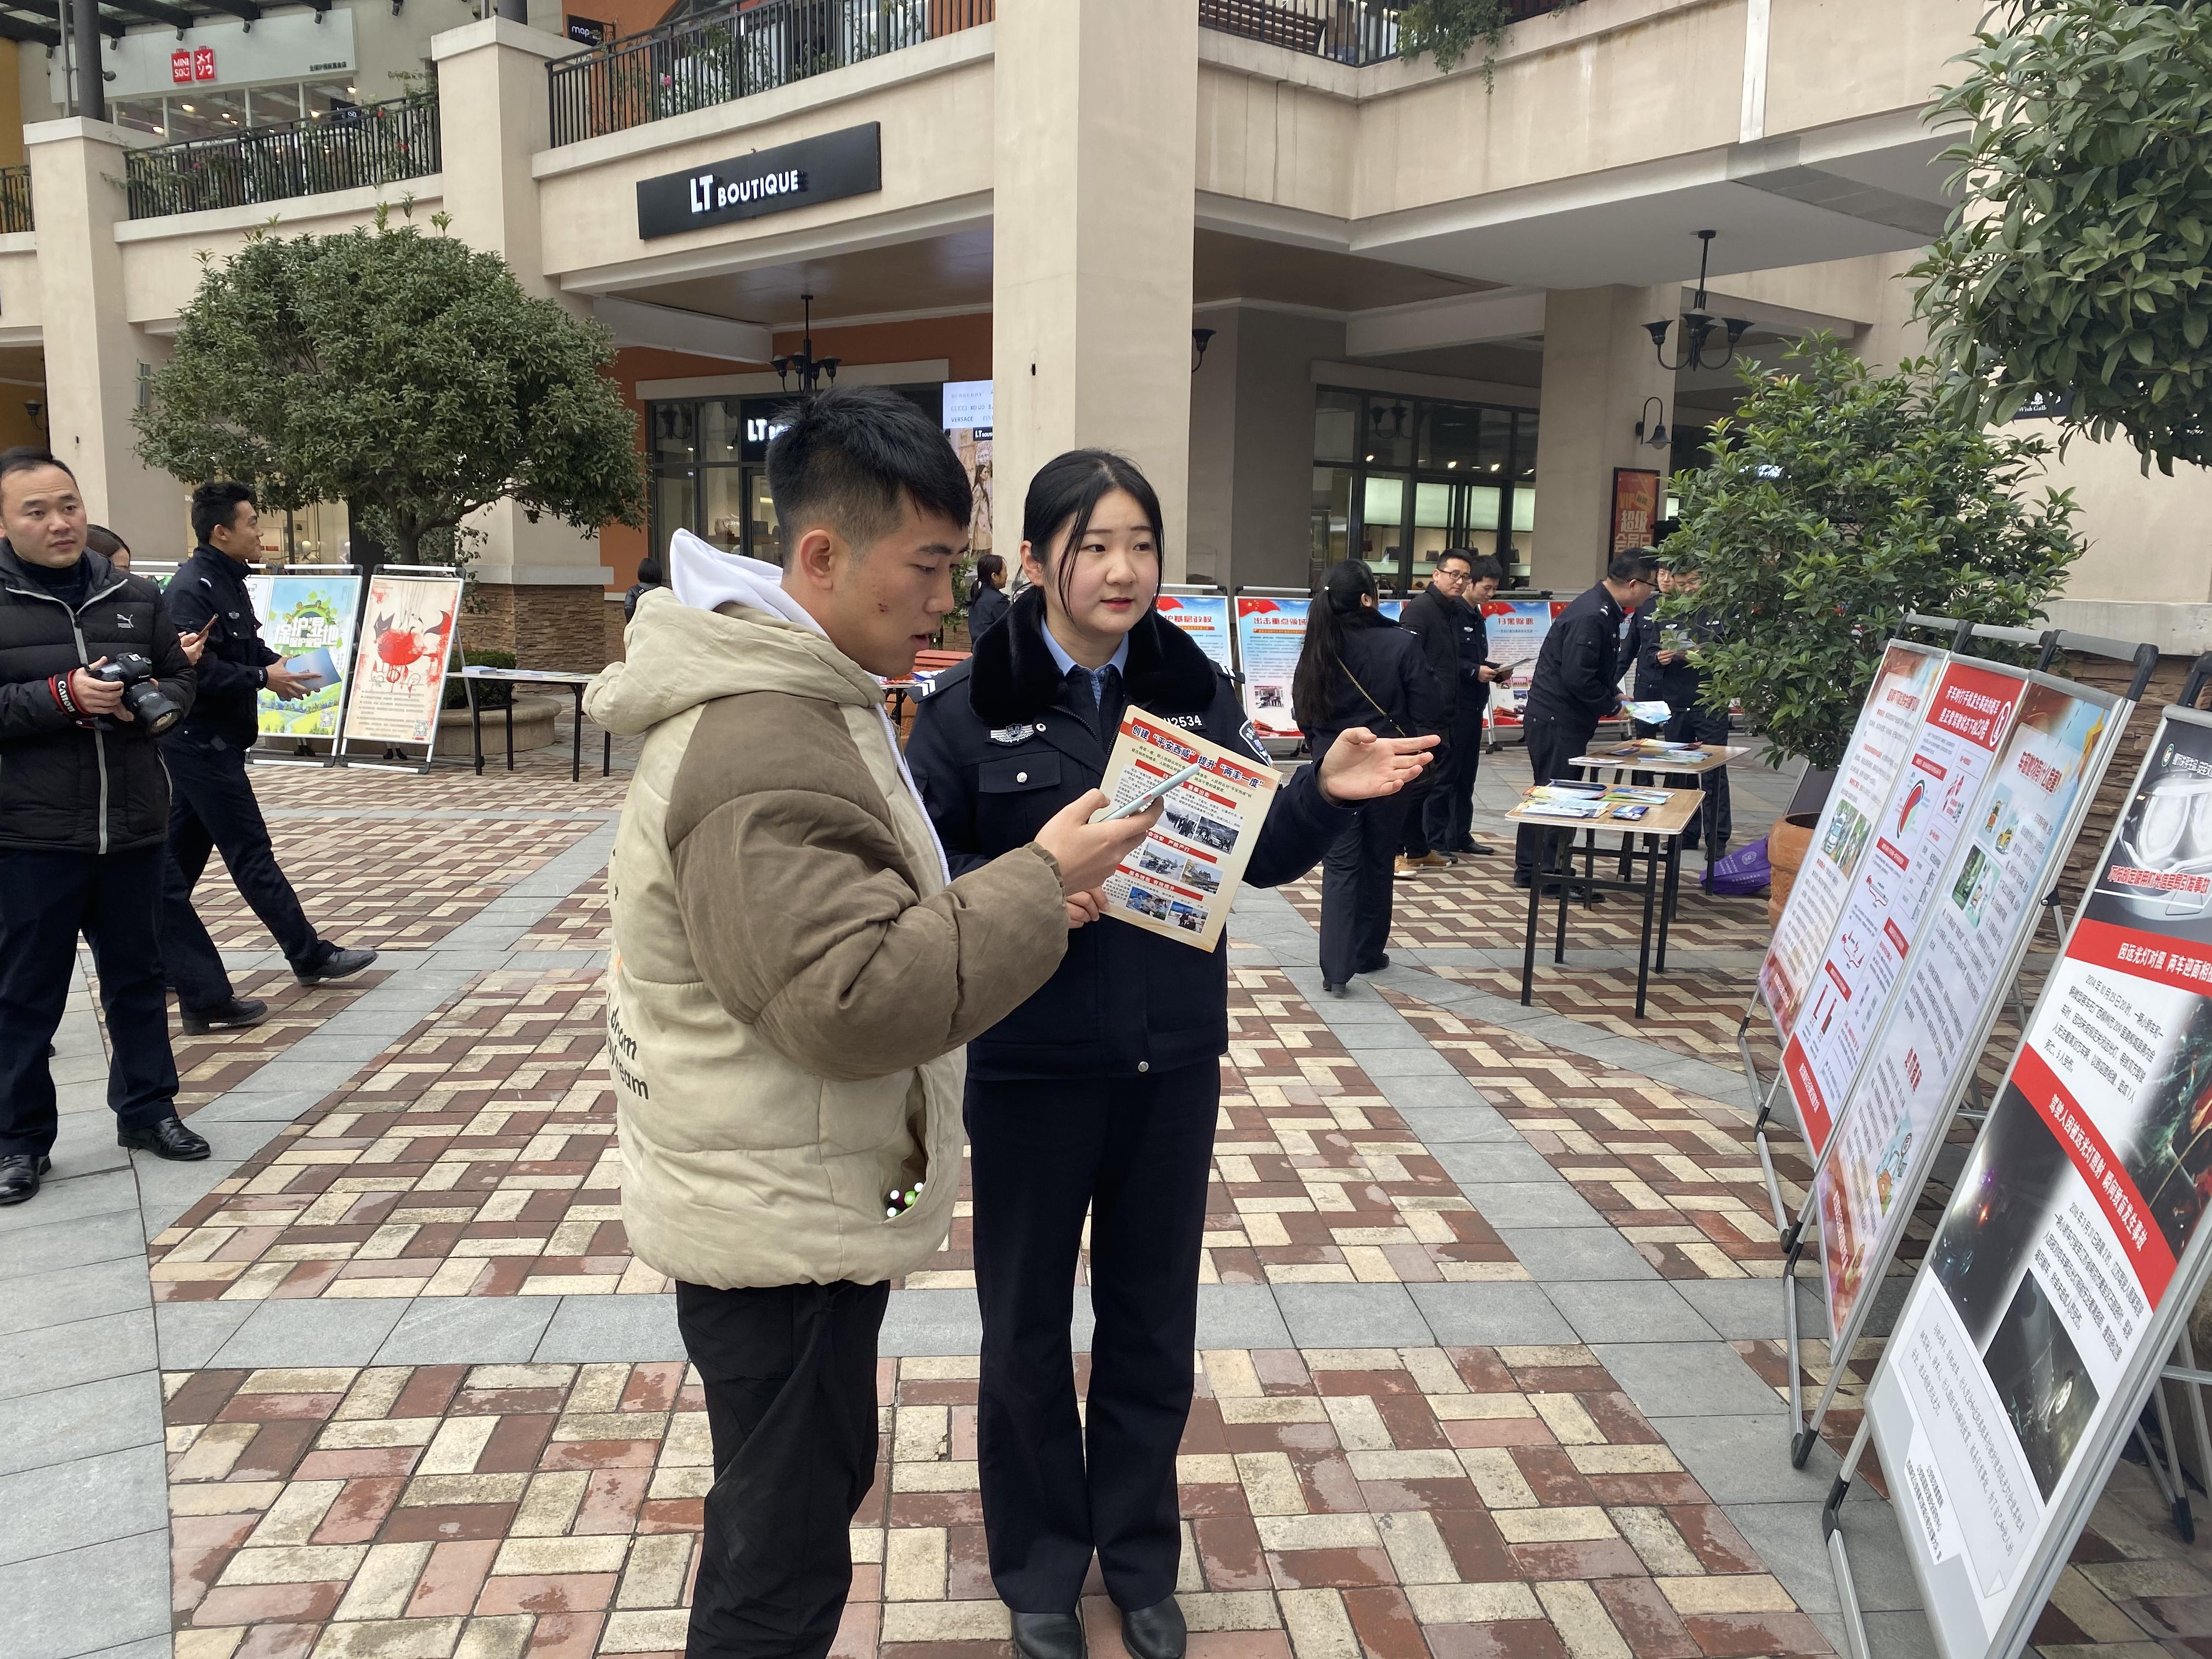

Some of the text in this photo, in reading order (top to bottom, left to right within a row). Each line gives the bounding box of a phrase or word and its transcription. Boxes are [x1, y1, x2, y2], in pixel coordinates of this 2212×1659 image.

[572, 25, 590, 38] map
[173, 58, 189, 67] MINI
[196, 52, 211, 64] メイ
[198, 64, 213, 76] ソウ
[690, 170, 798, 213] LT BOUTIQUE
[748, 419, 768, 442] LT
[1620, 492, 1635, 509] VIP
[1621, 510, 1647, 532] 超级
[275, 616, 339, 646] 保护湿地
[58, 680, 76, 712] Canon
[1132, 725, 1150, 740] 创建
[1198, 755, 1216, 770] 提升
[1187, 783, 1210, 798] 重拳出击
[1167, 839, 1190, 853] 严防严打
[1153, 878, 1175, 891] 有效提升
[2108, 865, 2211, 894] 不按规定使用灯光信号易引发事故
[2117, 943, 2168, 970] 因远光灯对照
[2047, 1093, 2148, 1252] 驾驶人因被远光灯照射 瞬间致盲发生事故
